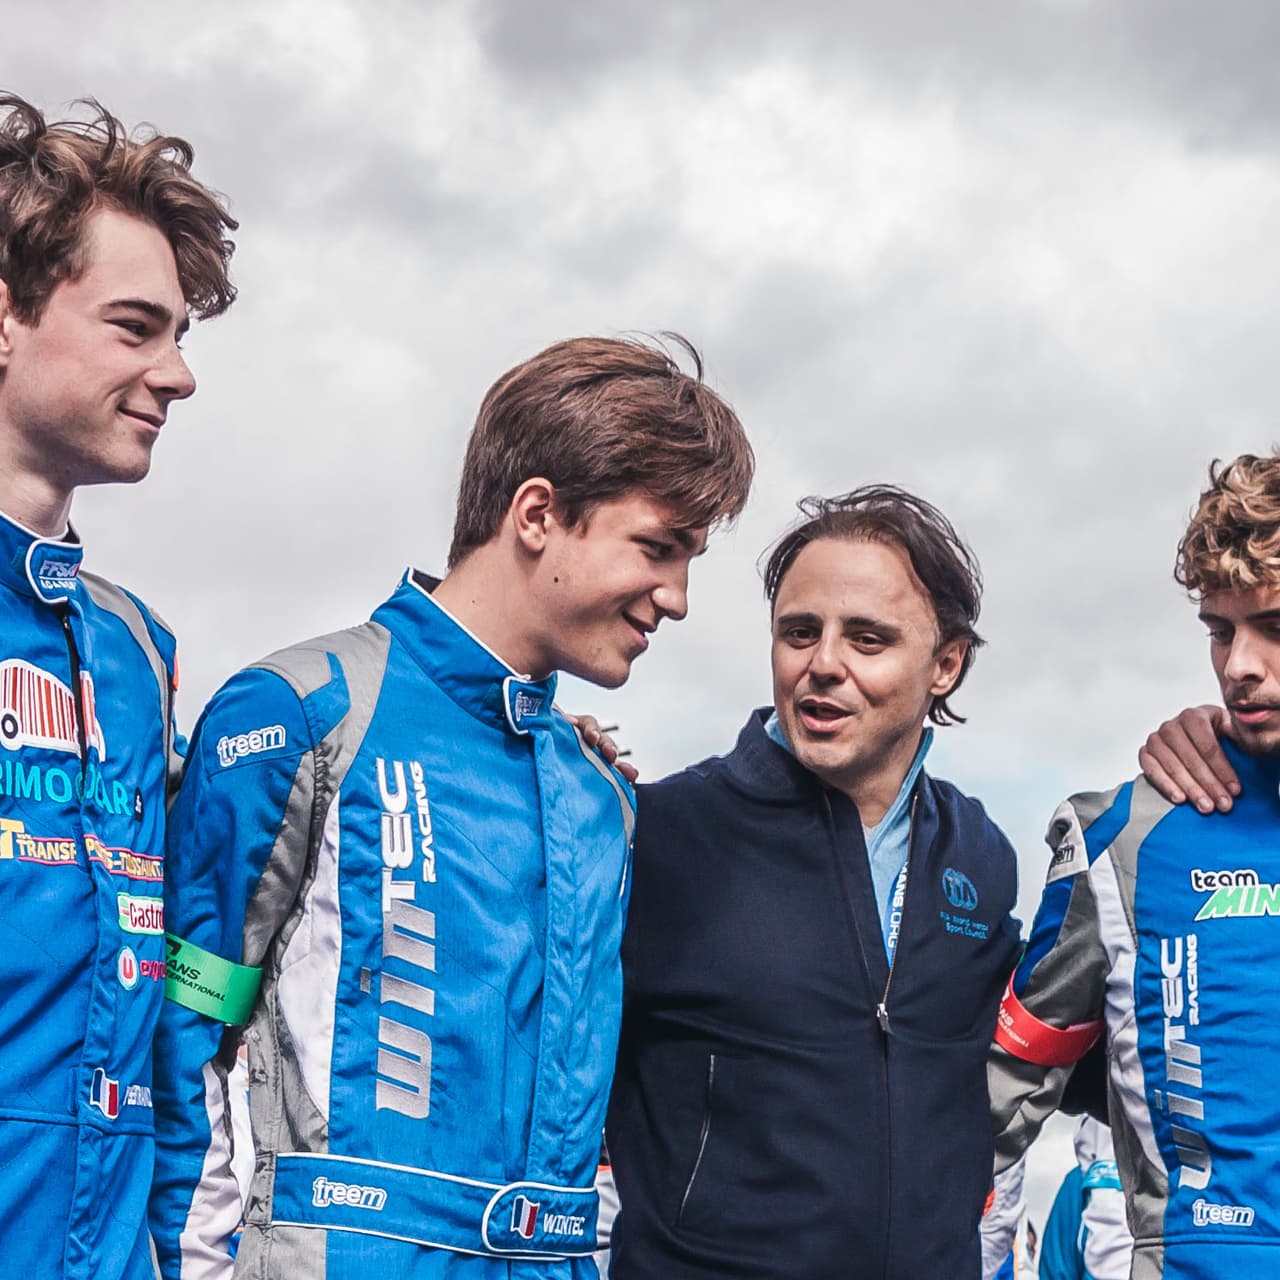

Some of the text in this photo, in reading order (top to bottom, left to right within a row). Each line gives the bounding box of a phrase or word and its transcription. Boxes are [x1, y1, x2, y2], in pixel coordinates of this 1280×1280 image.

[217, 725, 285, 767] freem
[410, 761, 437, 883] RACING
[1193, 870, 1257, 890] team
[1187, 933, 1200, 1026] RACING
[312, 1177, 387, 1211] freem
[543, 1213, 586, 1236] WINTEC
[1192, 1198, 1254, 1226] freem
